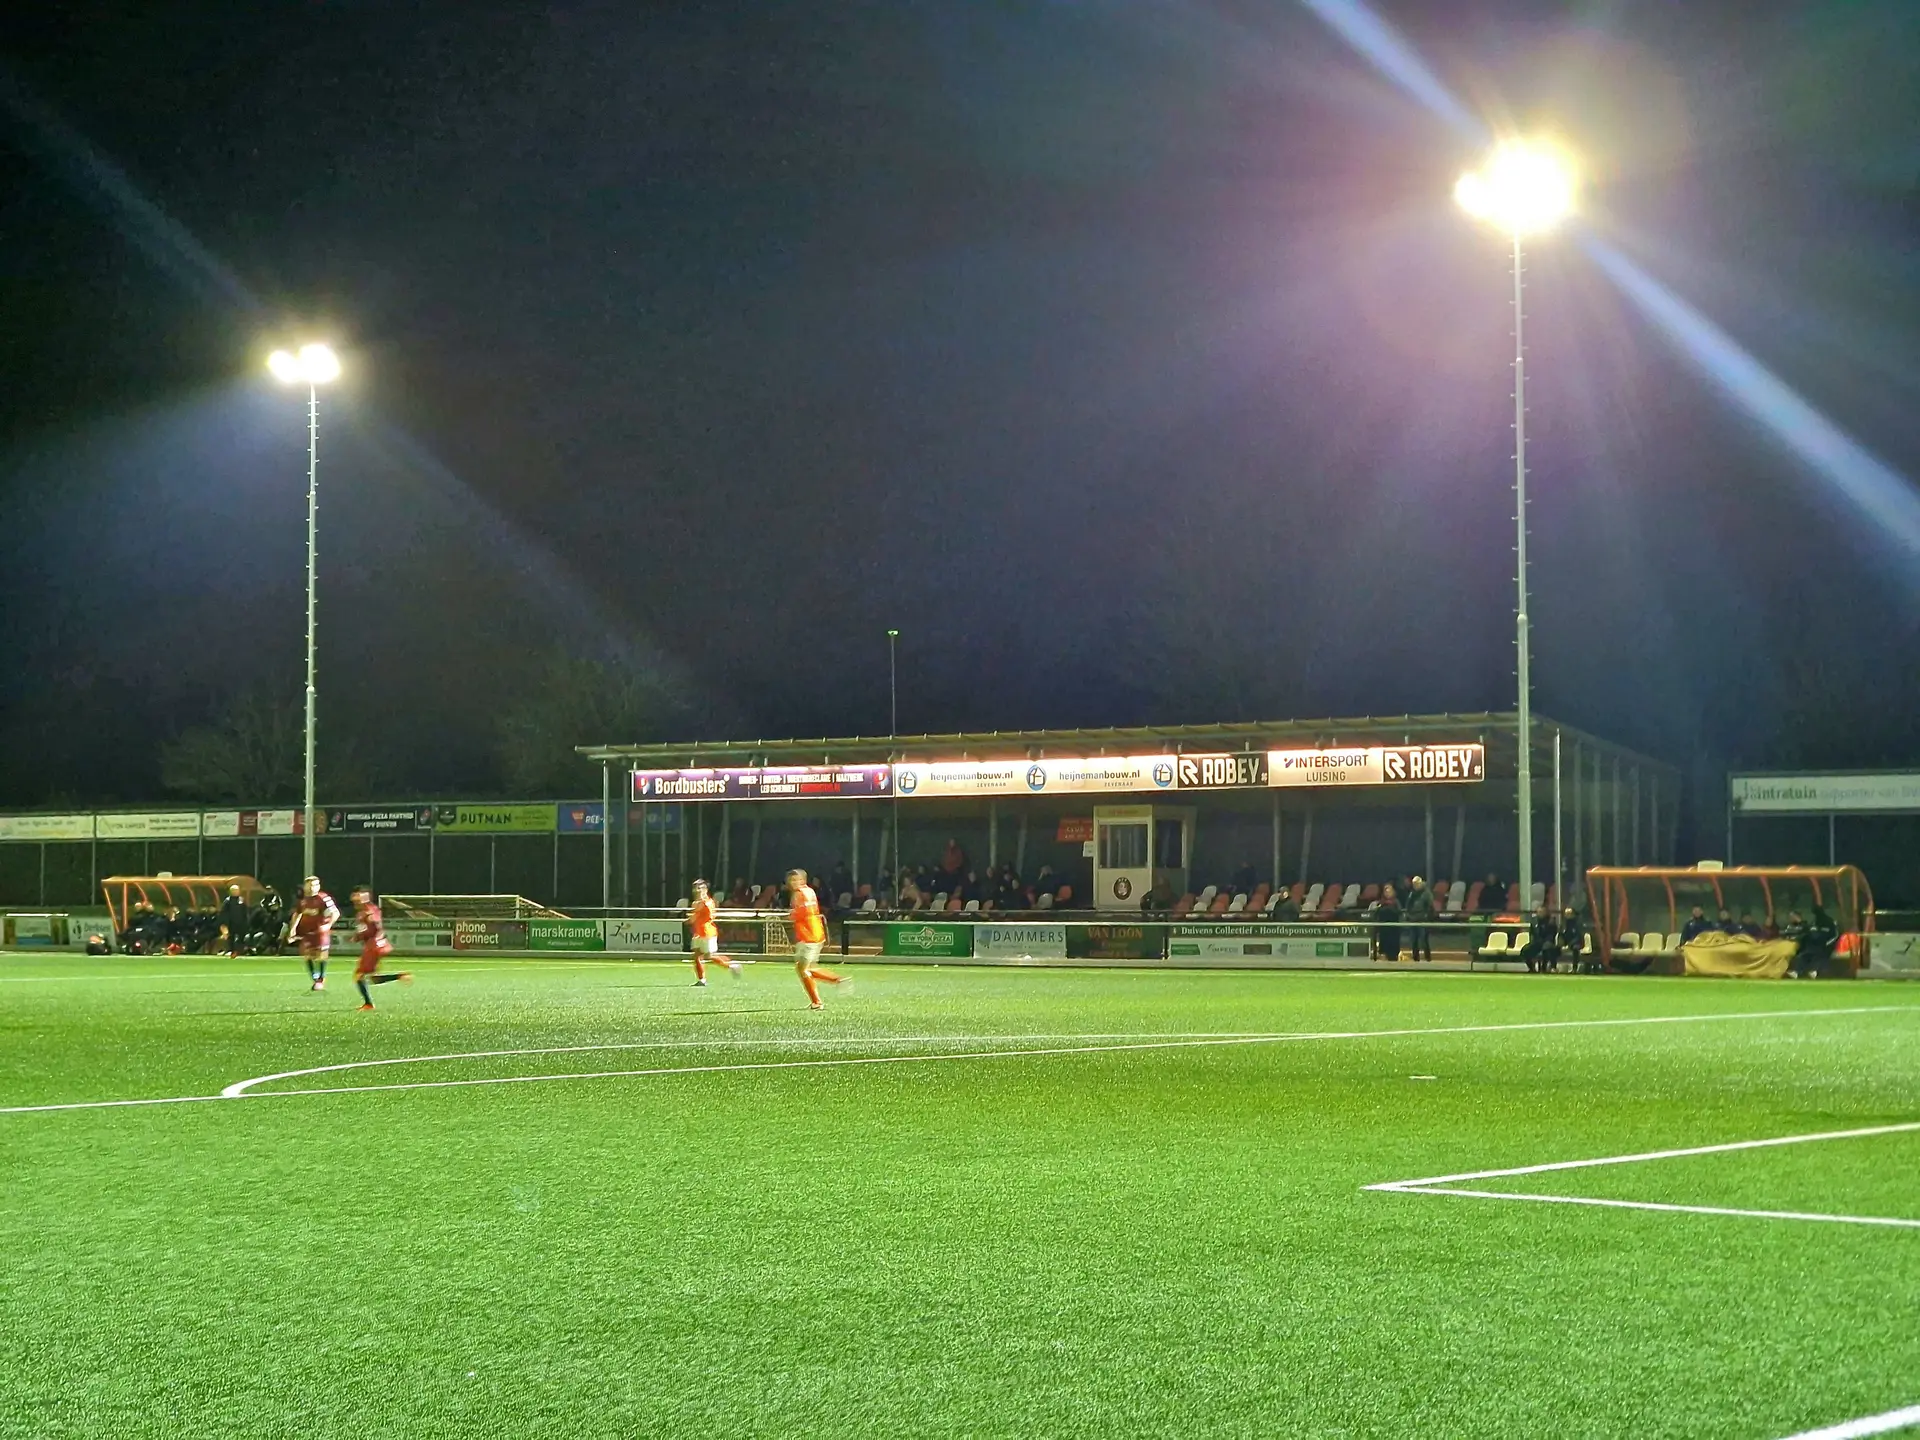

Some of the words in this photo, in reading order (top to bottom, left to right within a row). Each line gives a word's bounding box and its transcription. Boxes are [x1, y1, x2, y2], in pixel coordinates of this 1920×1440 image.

[1295, 754, 1368, 769] INTERSPORT
[1410, 750, 1473, 779] ROBEY
[930, 771, 1014, 784] heijnemanbouw.nl
[1059, 769, 1141, 782] heijnemanbouw.nl
[1202, 757, 1260, 785] ROBEY
[1306, 771, 1346, 782] LUISING
[655, 776, 727, 795] Bordbusters
[460, 813, 512, 824] PUTMAN
[456, 921, 486, 935] phone
[531, 925, 596, 938] marskramer
[1088, 927, 1109, 939] VAN
[1112, 927, 1143, 939] LOON
[1181, 926, 1213, 935] Duivens
[1215, 926, 1253, 935] Collectief
[1260, 926, 1322, 937] Hoofdsponsors
[1341, 926, 1358, 935] DVV
[460, 933, 499, 945] connect
[624, 930, 682, 945] IMPECO
[993, 930, 1064, 943] DAMMERS
